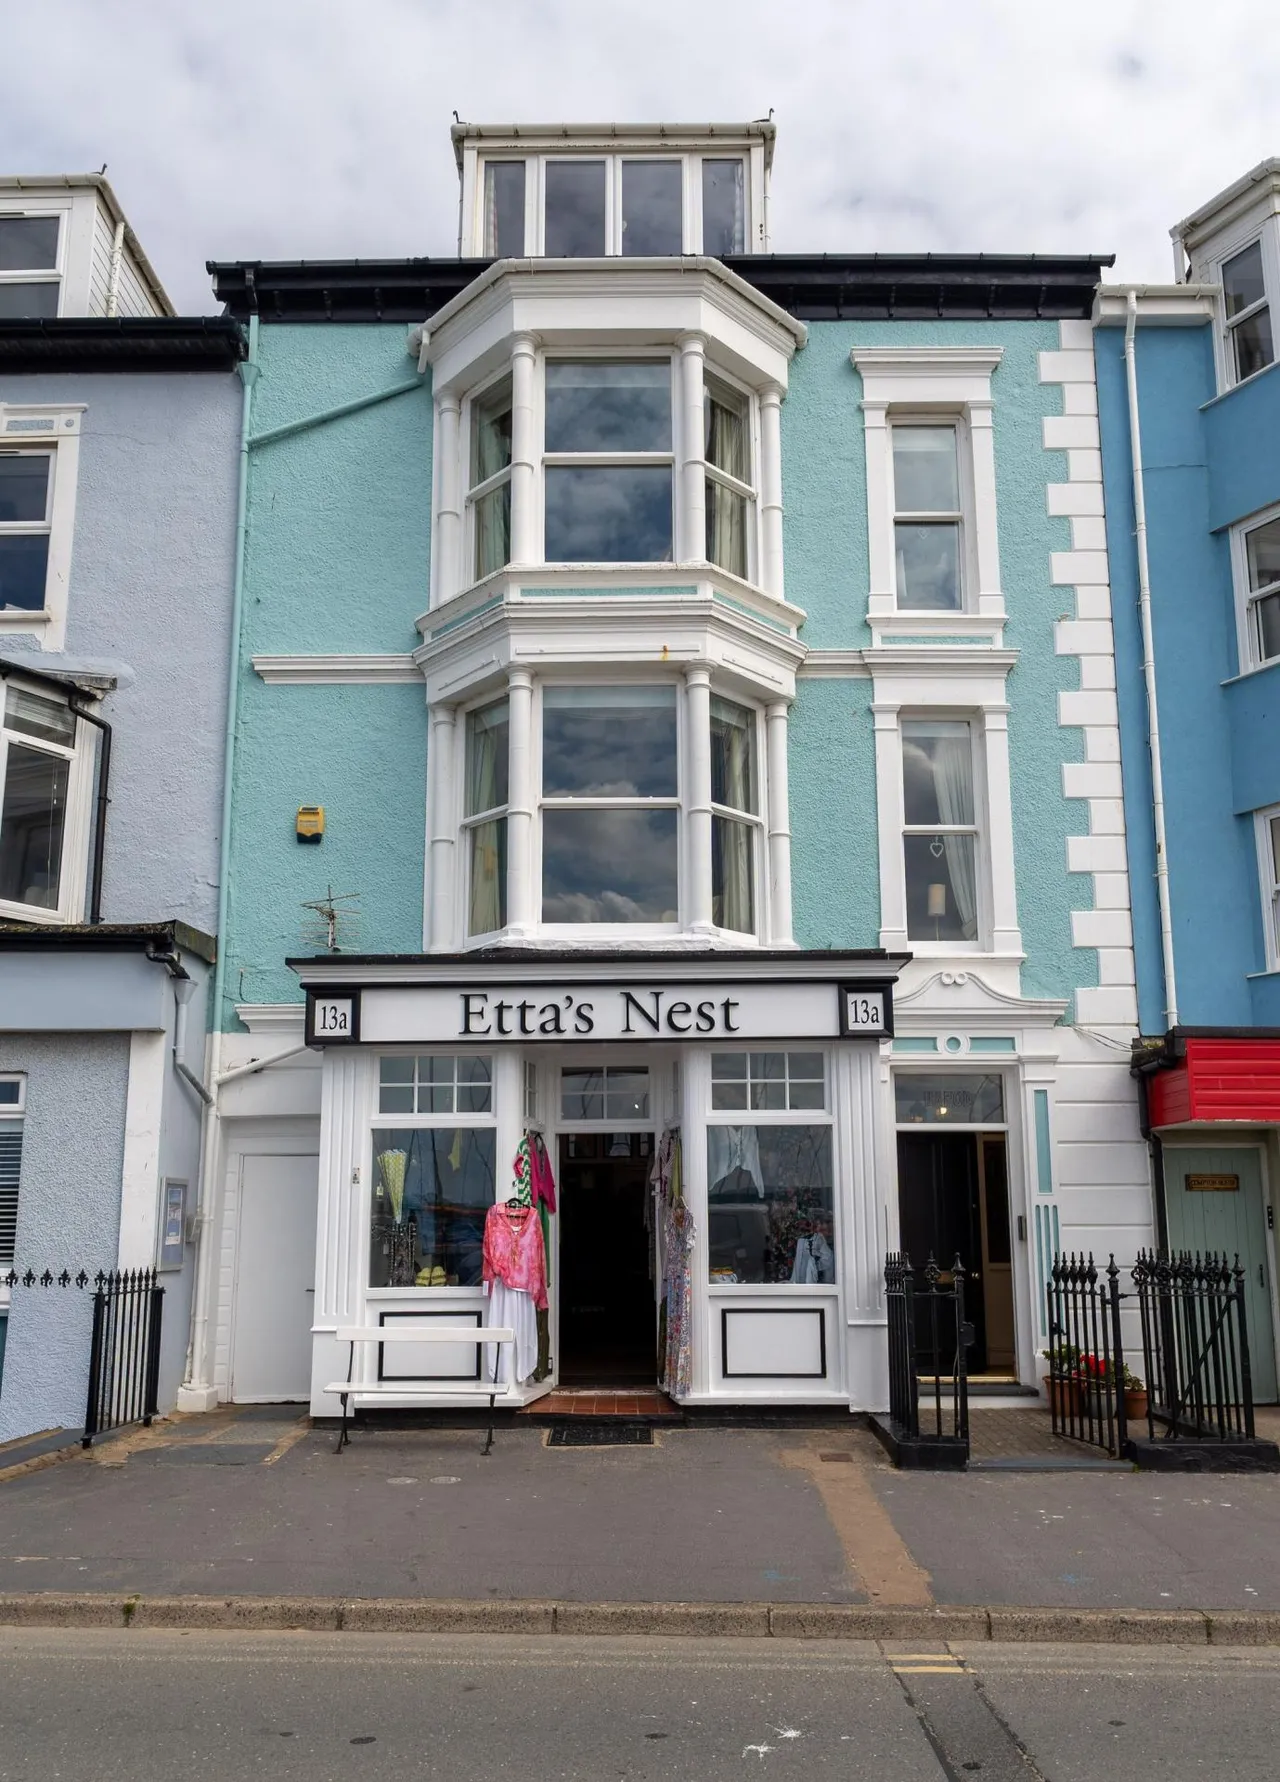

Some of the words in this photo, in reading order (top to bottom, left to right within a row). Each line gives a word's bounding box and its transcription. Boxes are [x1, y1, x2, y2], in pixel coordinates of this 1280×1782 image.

[320, 1005, 348, 1030] 13a
[458, 993, 595, 1036] Etta's
[619, 991, 740, 1033] Nest
[850, 999, 881, 1025] 13a
